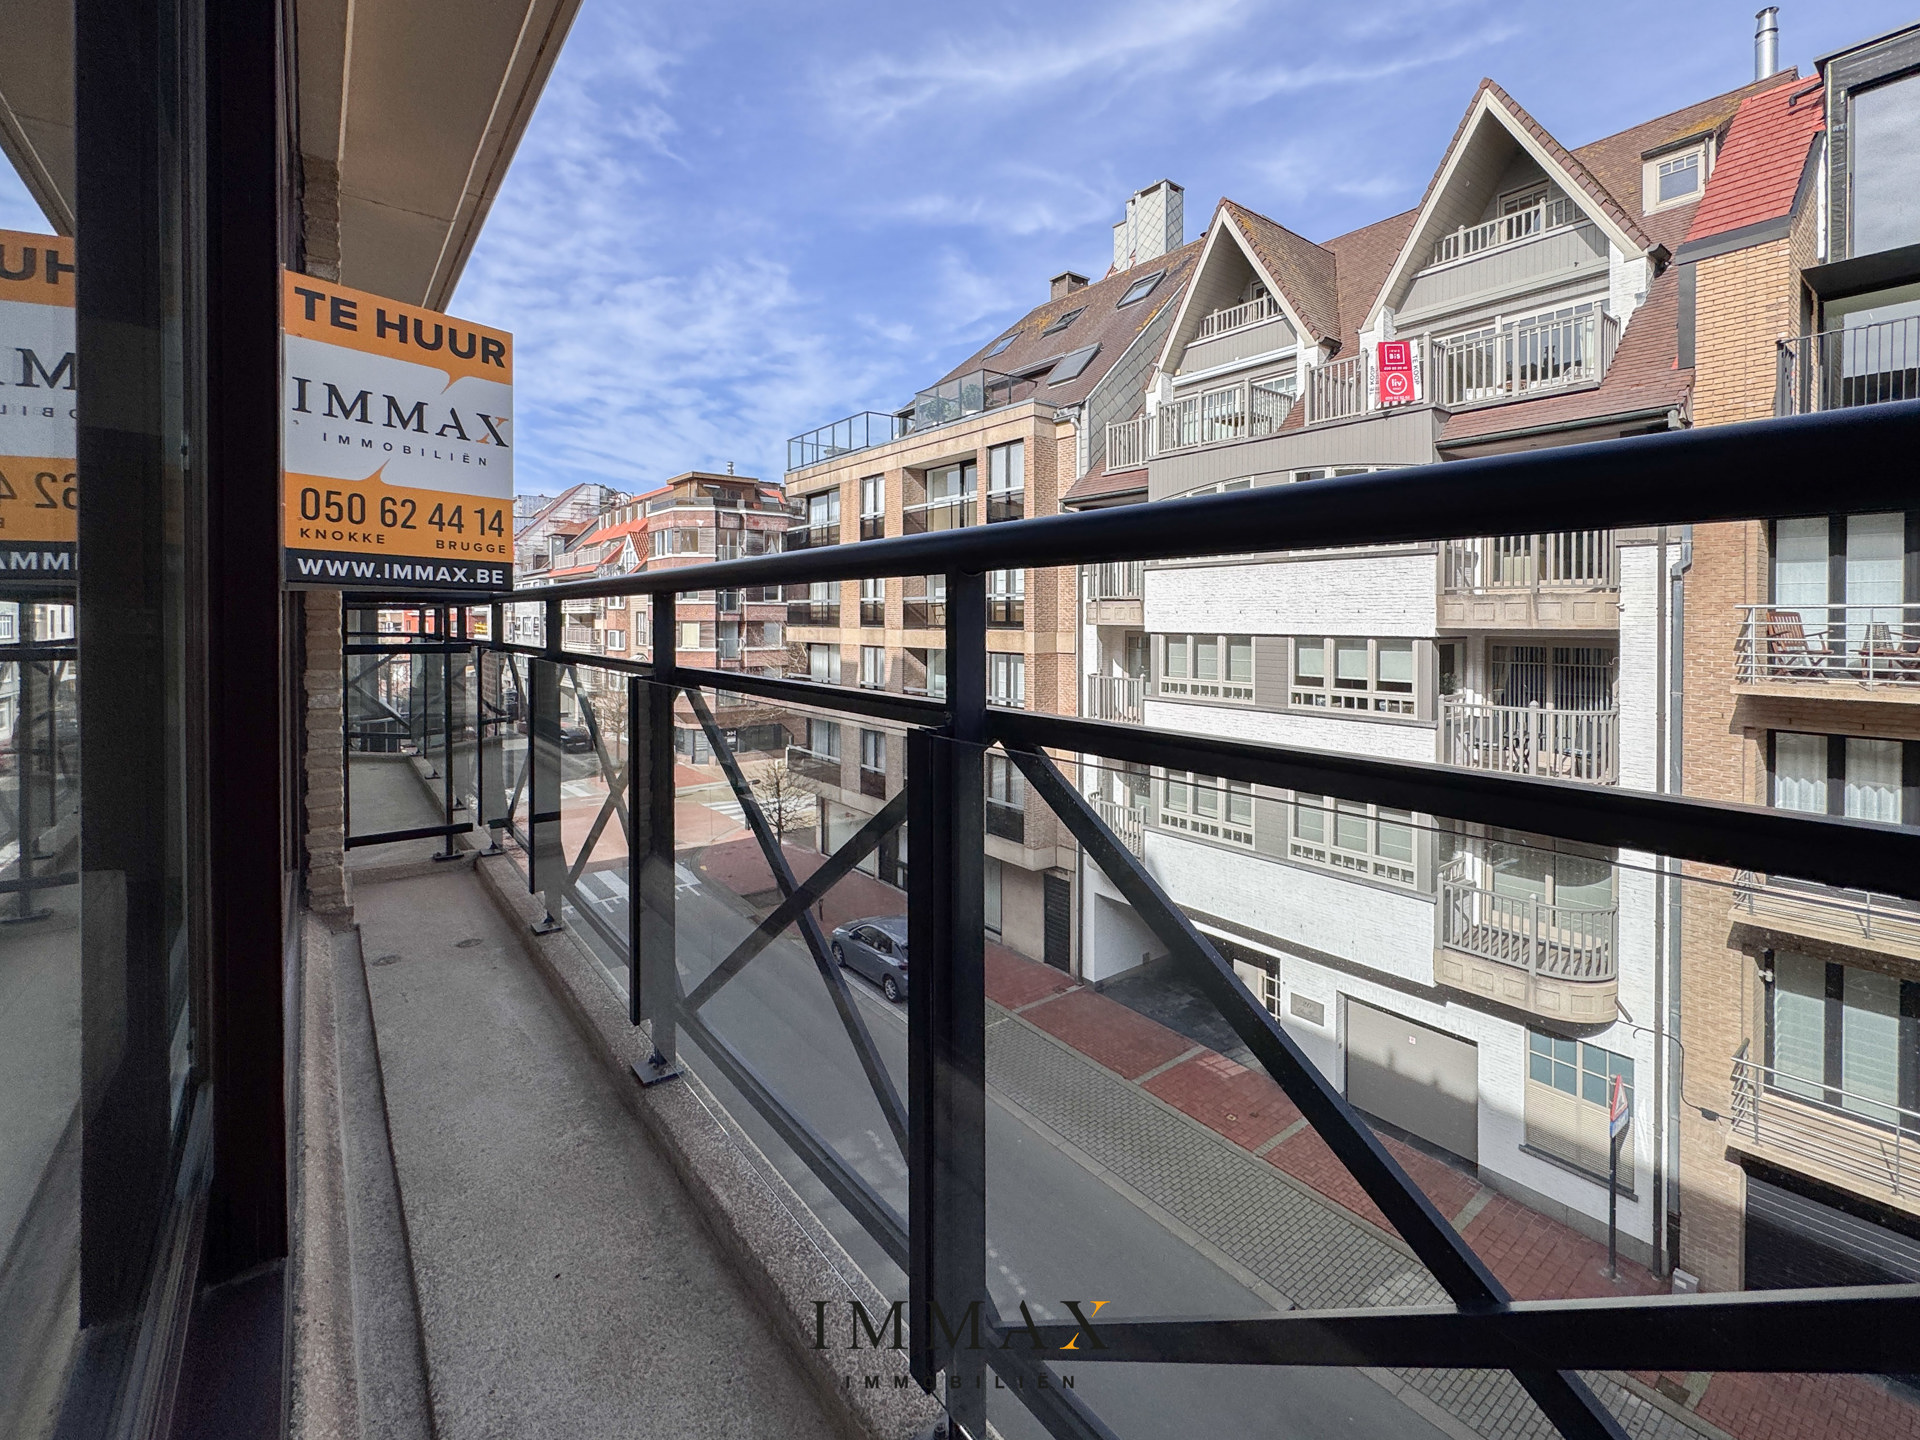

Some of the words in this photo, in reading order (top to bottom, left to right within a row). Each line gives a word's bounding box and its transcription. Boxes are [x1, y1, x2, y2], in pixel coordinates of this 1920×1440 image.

[294, 286, 357, 332] TE
[376, 308, 506, 369] HUUR
[1412, 355, 1419, 364] TE
[1413, 365, 1421, 385] KOOP
[292, 376, 510, 448] IMMAX
[323, 432, 487, 466] IMMOBILIËN
[300, 487, 367, 524] 050
[380, 496, 417, 530] 62
[428, 502, 465, 534] 44
[474, 507, 504, 537] 14
[300, 527, 386, 544] KNOKKE
[436, 539, 507, 554] BRUGGE
[297, 557, 504, 585] WWW.IMMAX.BE
